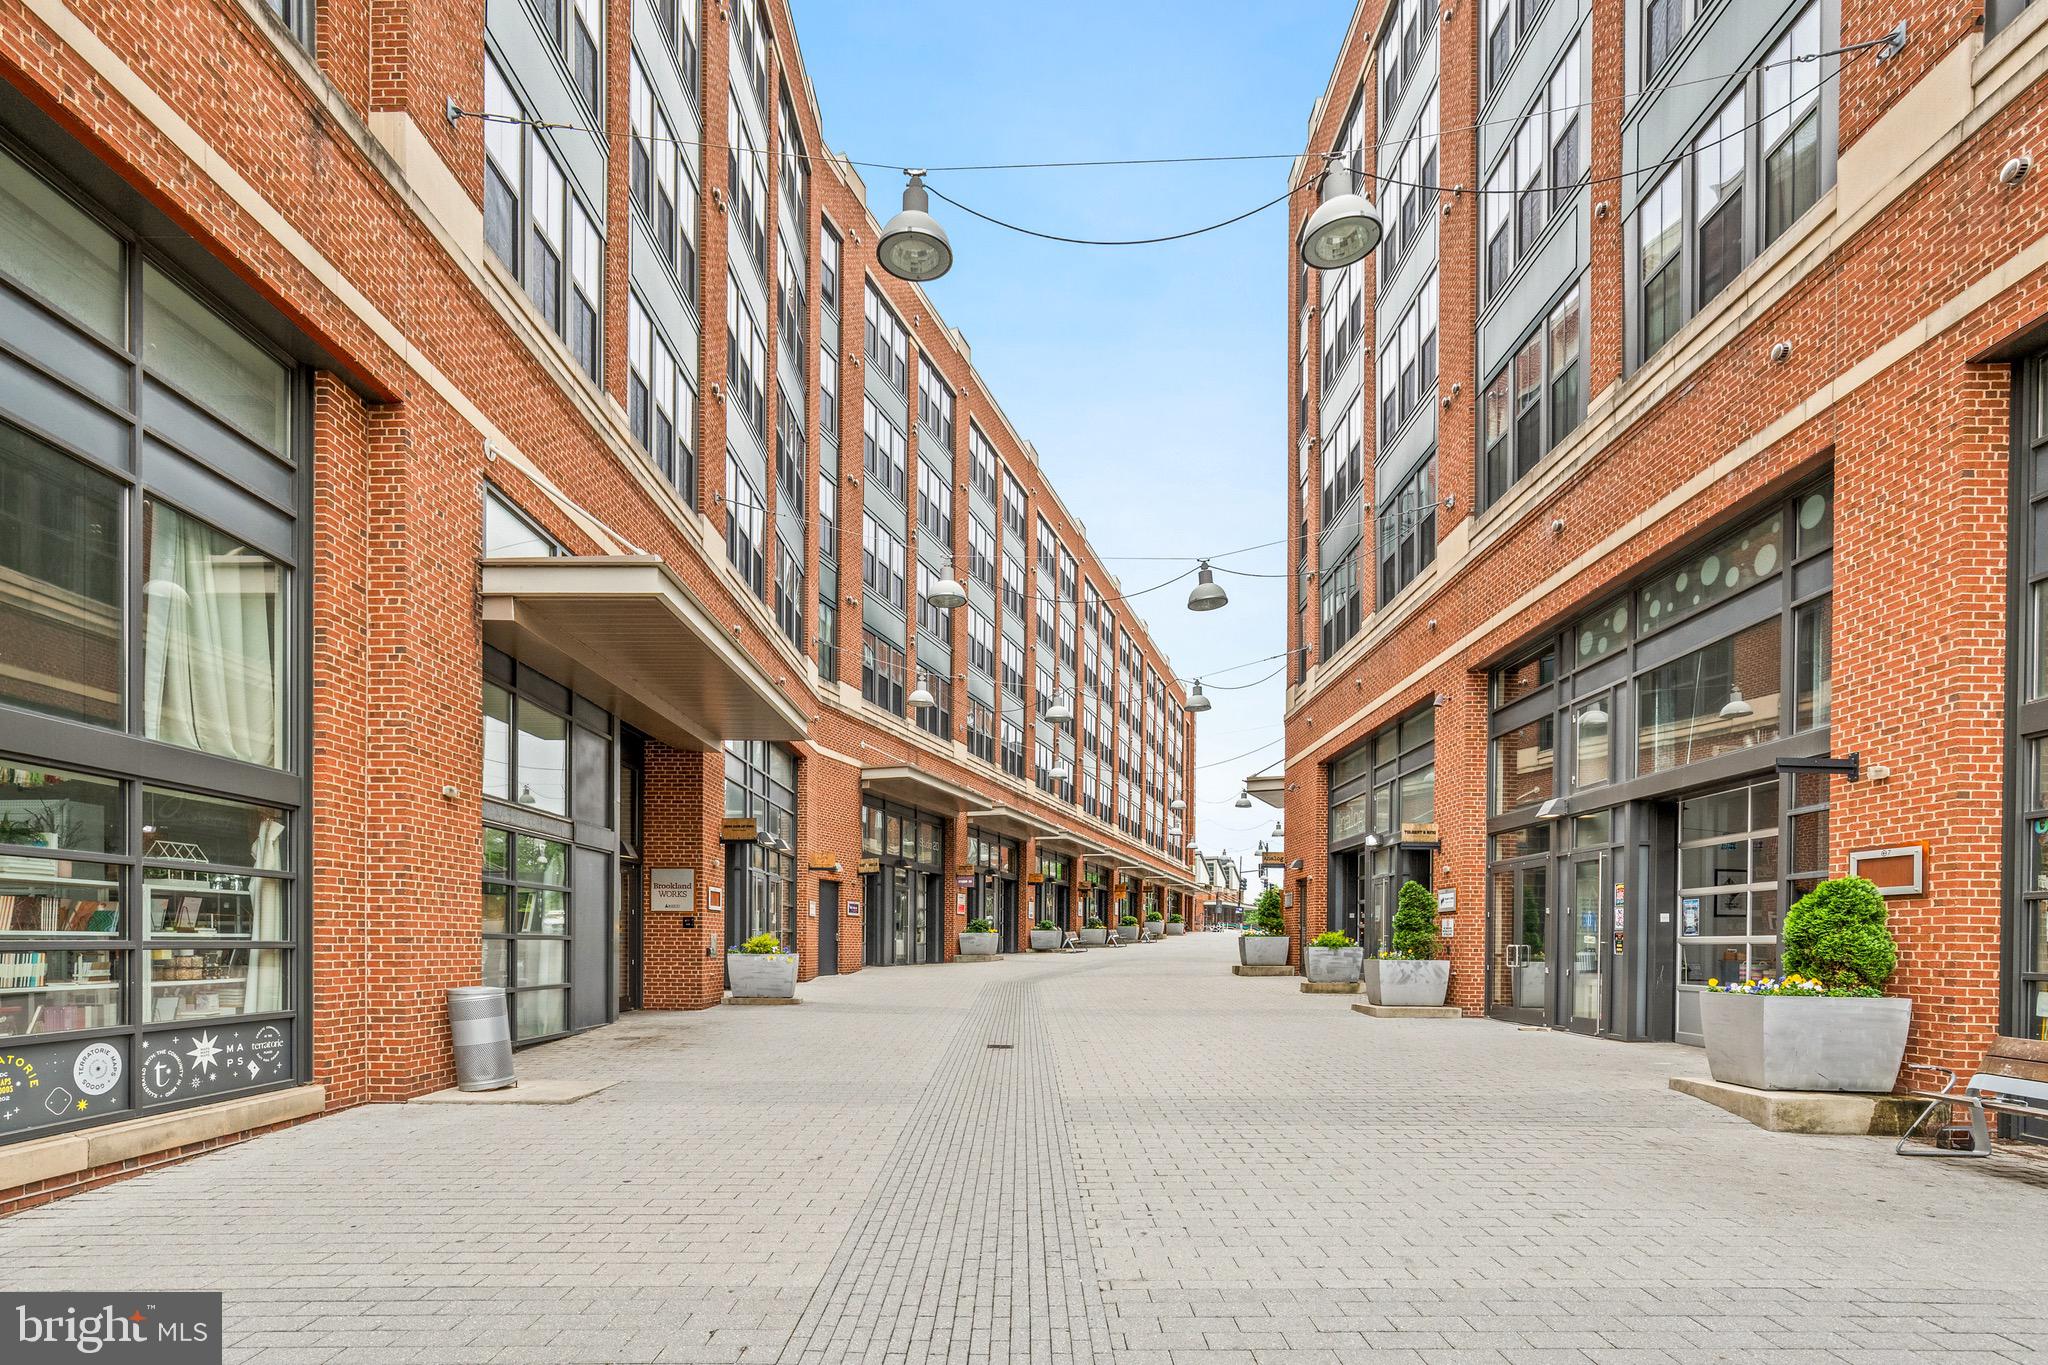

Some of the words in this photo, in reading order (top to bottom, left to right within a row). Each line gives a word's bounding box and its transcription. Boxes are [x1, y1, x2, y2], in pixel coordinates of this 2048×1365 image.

[653, 882, 692, 890] Brookland
[658, 890, 688, 898] WORKS
[251, 1039, 284, 1050] terratorie
[78, 1048, 111, 1076] TERRATORIE
[167, 1050, 184, 1078] COMMUNITY
[82, 1079, 105, 1090] GOODS
